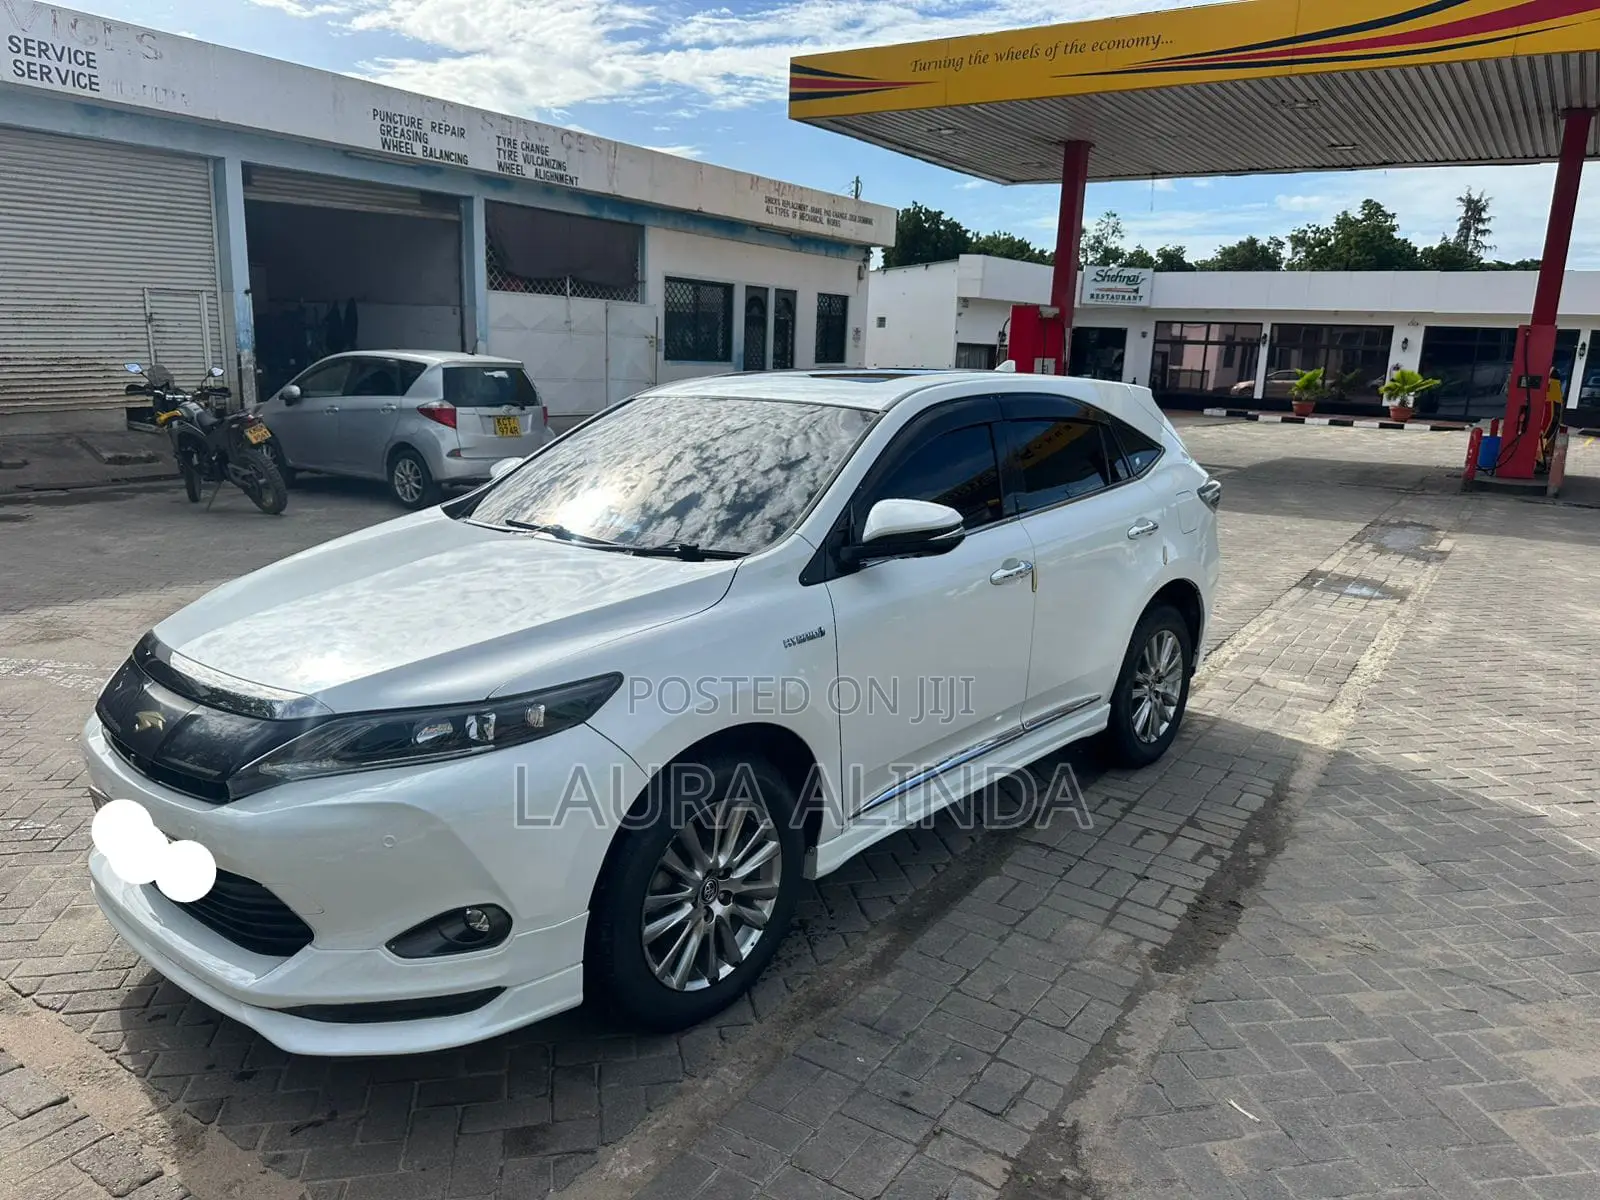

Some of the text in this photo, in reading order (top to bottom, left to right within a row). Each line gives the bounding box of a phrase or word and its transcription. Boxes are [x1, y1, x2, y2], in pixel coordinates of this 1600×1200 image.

[8, 35, 97, 70] SERVICE
[910, 33, 1173, 72] Turning the wheels of the economy...
[13, 59, 100, 92] SERVICE
[372, 108, 423, 130] PUNCTURE
[430, 121, 466, 139] REPAIR
[380, 124, 428, 144] GREASING
[381, 137, 469, 165] WHEEL BALANCING
[496, 135, 550, 156] TYRE CHANGE
[496, 147, 567, 172] TYRE VULCANIZING
[497, 160, 526, 176] WHEEL
[766, 205, 774, 215] ALL
[775, 206, 789, 219] TYPES
[799, 211, 824, 225] MECHANICAL
[1089, 293, 1144, 302] RESTAURANT
